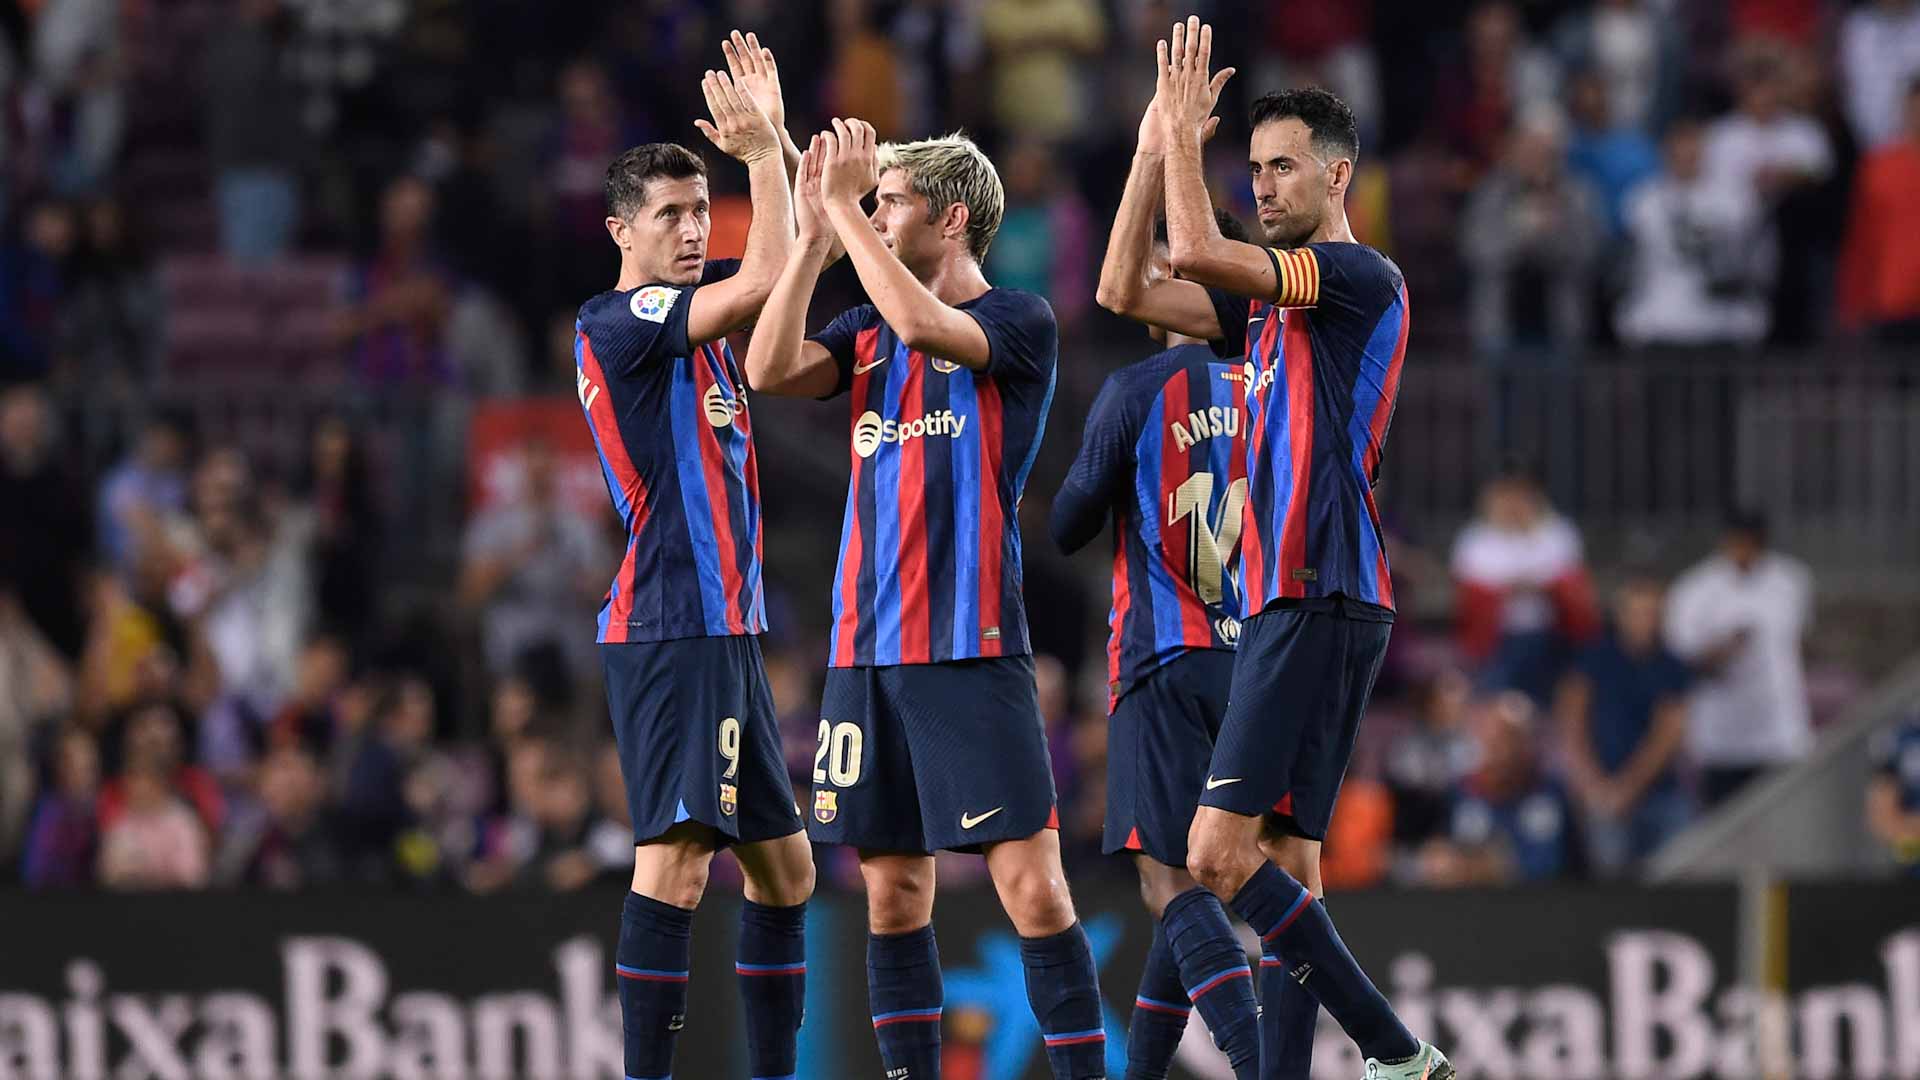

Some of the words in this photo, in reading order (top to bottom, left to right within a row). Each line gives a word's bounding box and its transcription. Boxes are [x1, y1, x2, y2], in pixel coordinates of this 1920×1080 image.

[882, 409, 967, 446] Spotify
[1170, 406, 1239, 454] ANSU
[718, 717, 740, 780] 9
[812, 719, 863, 788] 20
